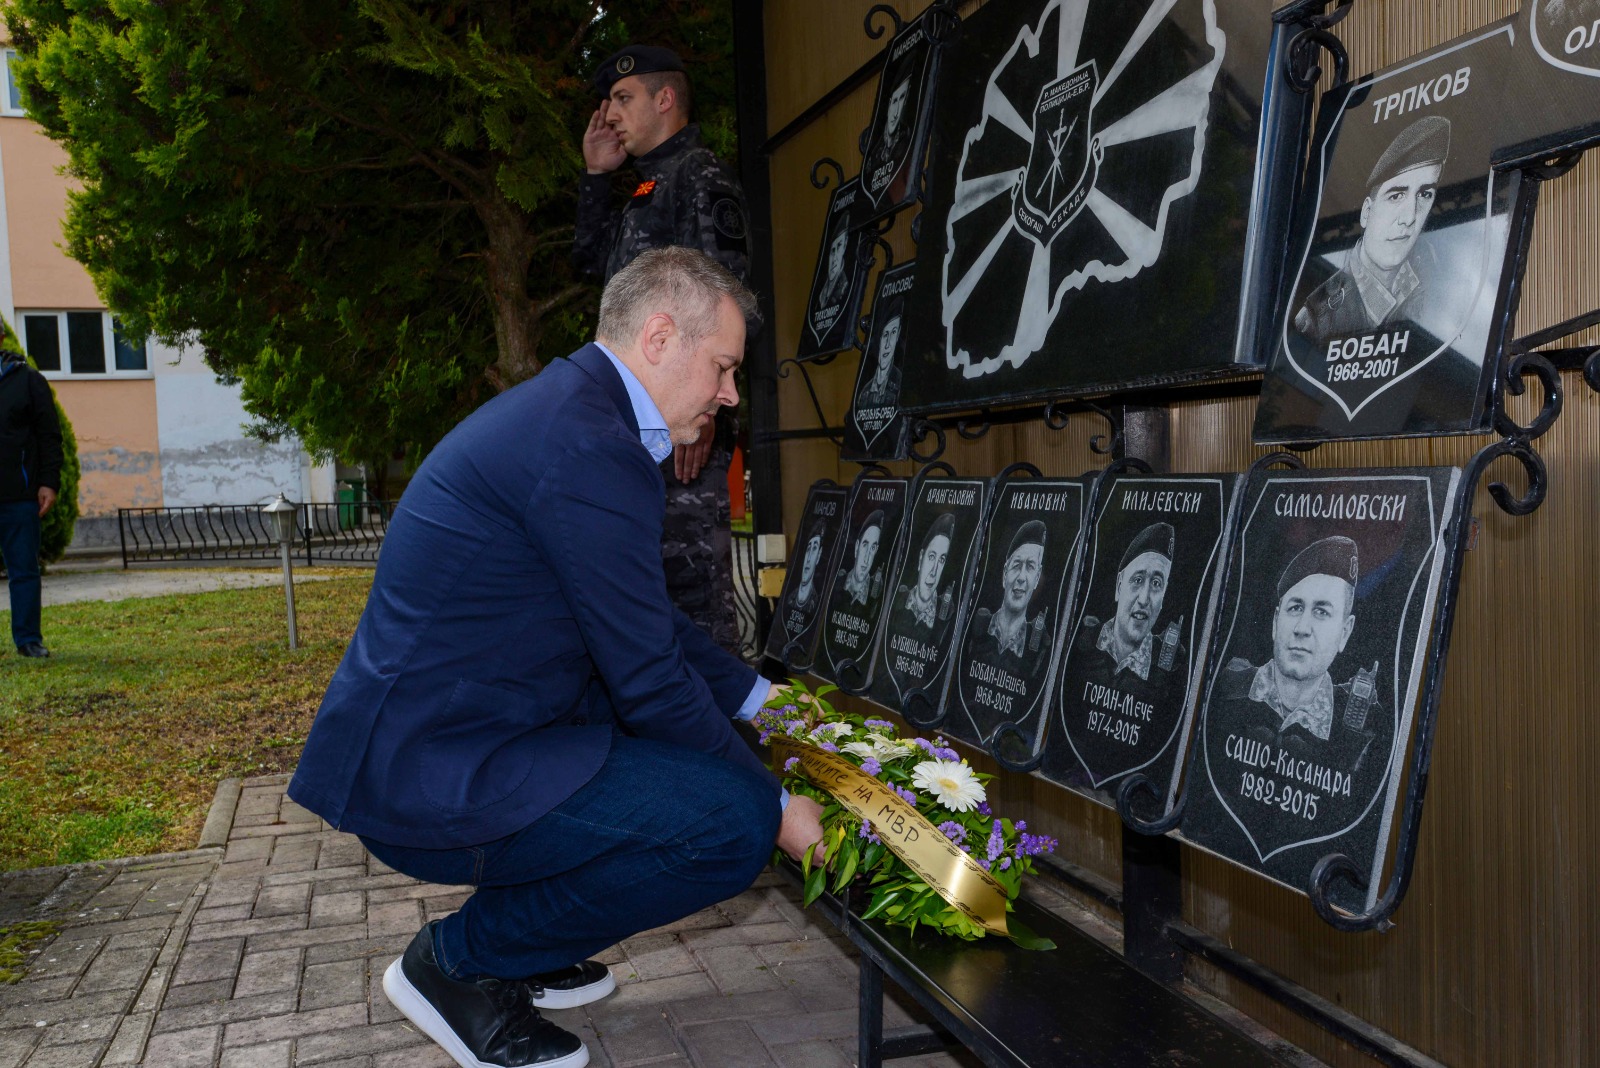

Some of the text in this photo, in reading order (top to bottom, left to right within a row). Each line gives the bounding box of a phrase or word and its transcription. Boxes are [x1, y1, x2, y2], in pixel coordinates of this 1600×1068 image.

[1050, 70, 1089, 96] МАКЕДОНИЈА
[1371, 66, 1471, 124] ТРПКОВ
[872, 160, 894, 183] ДРАГО
[1018, 187, 1086, 234] СЕКОГАШ СЕКАДЕ
[814, 304, 840, 322] ТИХОМИР
[1325, 330, 1410, 362] БОБАН
[1326, 356, 1400, 383] 1968-2001
[813, 501, 836, 516] МАНОВ
[1121, 490, 1202, 514] ИЛИЈЕВСКИ
[1274, 492, 1408, 523] САМОЈЛОВСКИ
[975, 685, 1014, 714] 1968-2015
[1087, 709, 1141, 746] 1974-2015
[1240, 771, 1320, 821] 1982-2015
[853, 784, 873, 804] НА
[877, 804, 920, 844] МВР
